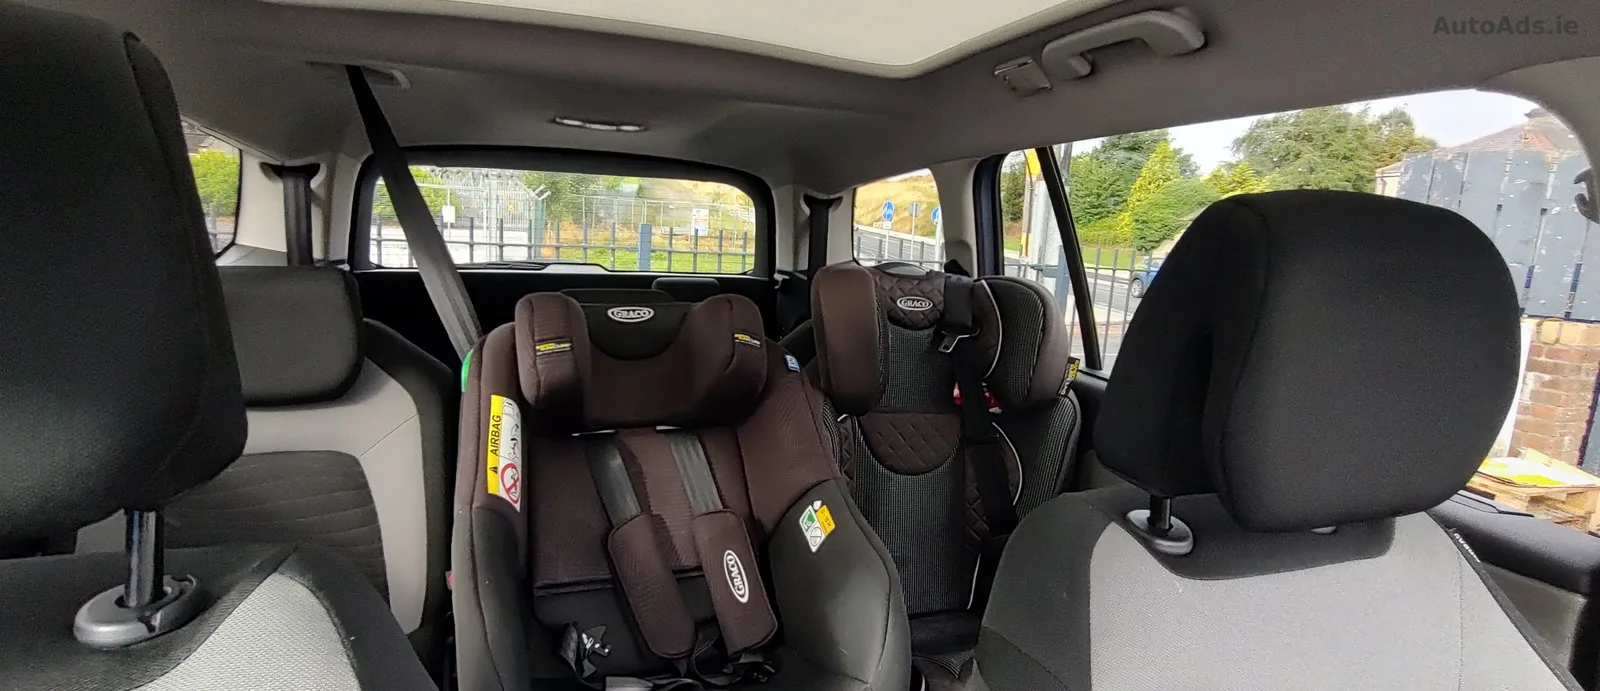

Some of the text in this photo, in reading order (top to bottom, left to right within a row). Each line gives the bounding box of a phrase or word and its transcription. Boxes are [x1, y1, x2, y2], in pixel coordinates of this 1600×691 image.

[612, 308, 651, 320] GRACO
[900, 298, 930, 309] GRACO
[490, 414, 502, 457] AIRBAG
[725, 553, 746, 597] GRACO
